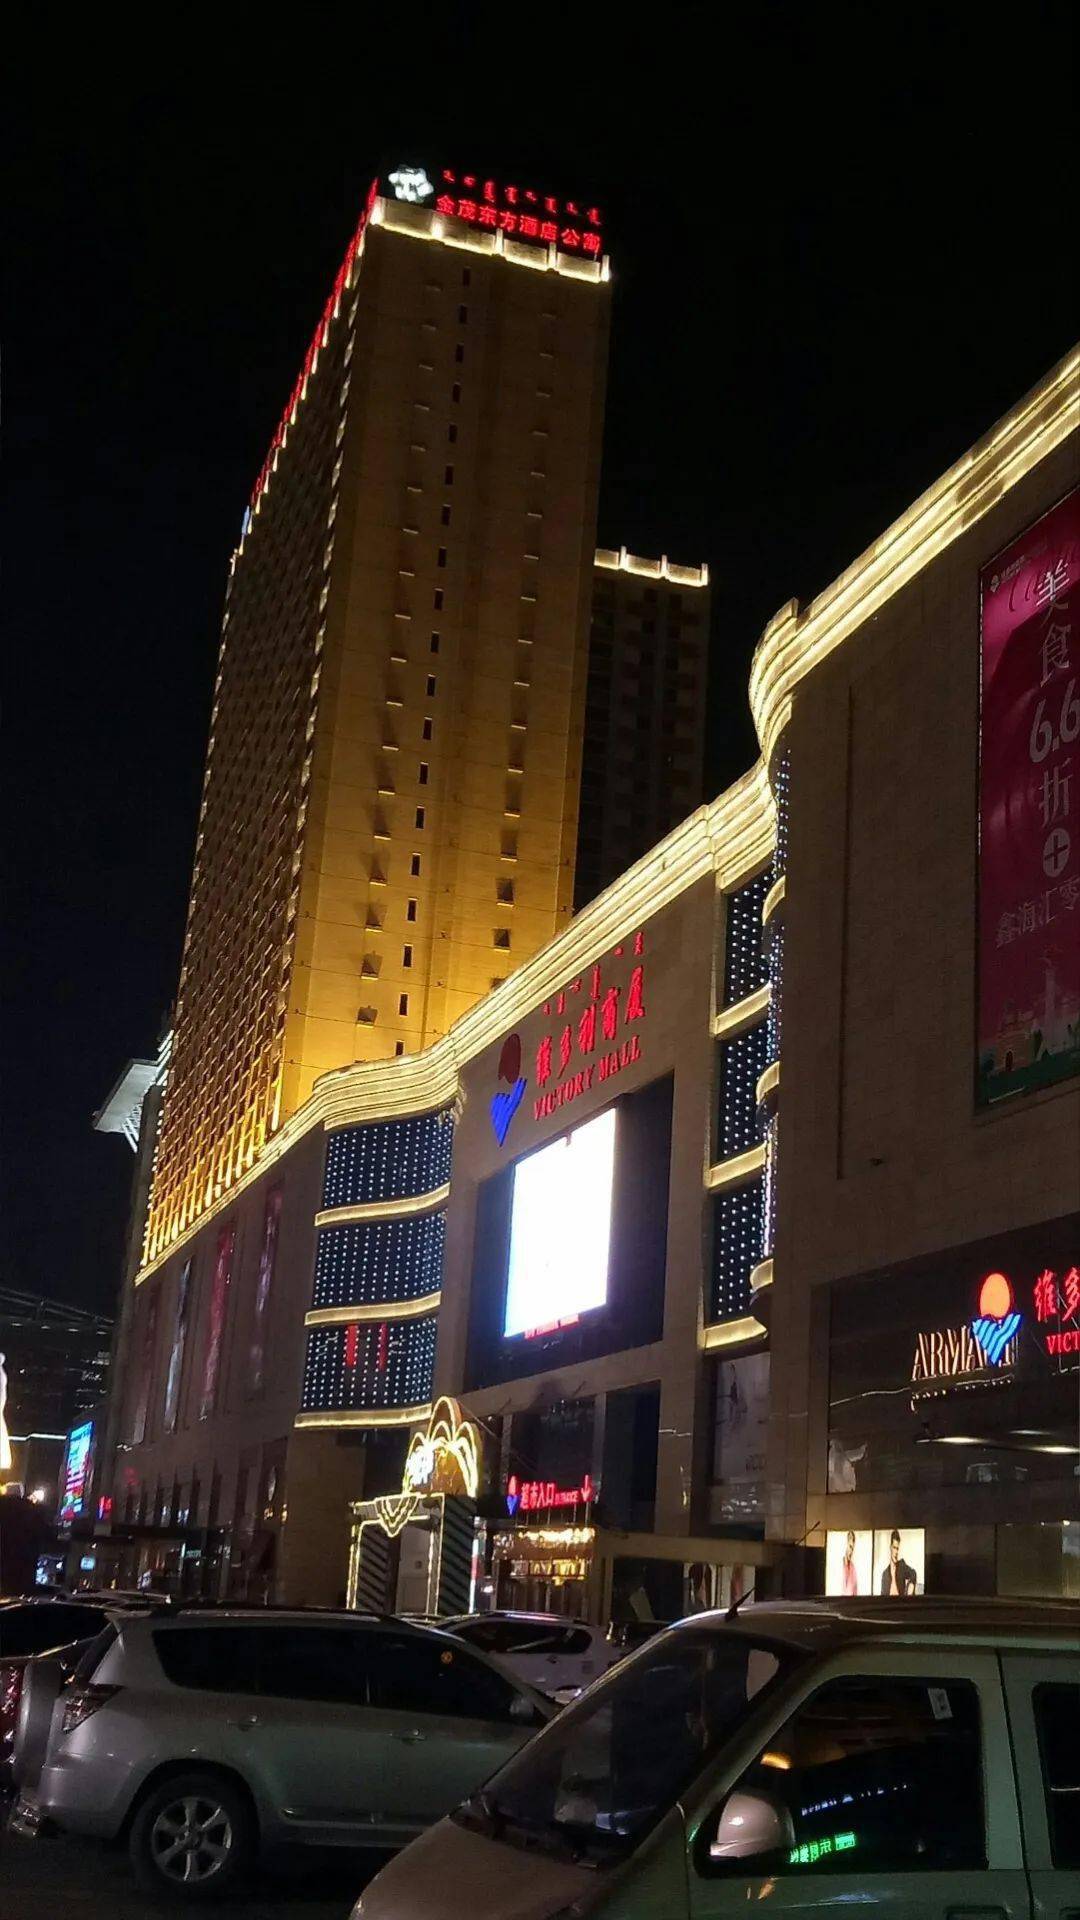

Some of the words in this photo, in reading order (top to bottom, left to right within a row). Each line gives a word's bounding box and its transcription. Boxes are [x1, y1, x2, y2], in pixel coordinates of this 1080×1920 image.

[436, 194, 601, 251] 金茂东方酒店公寓
[533, 1063, 596, 1121] VICTORY
[598, 1034, 642, 1083] MALL
[910, 1324, 1020, 1382] ARMAI
